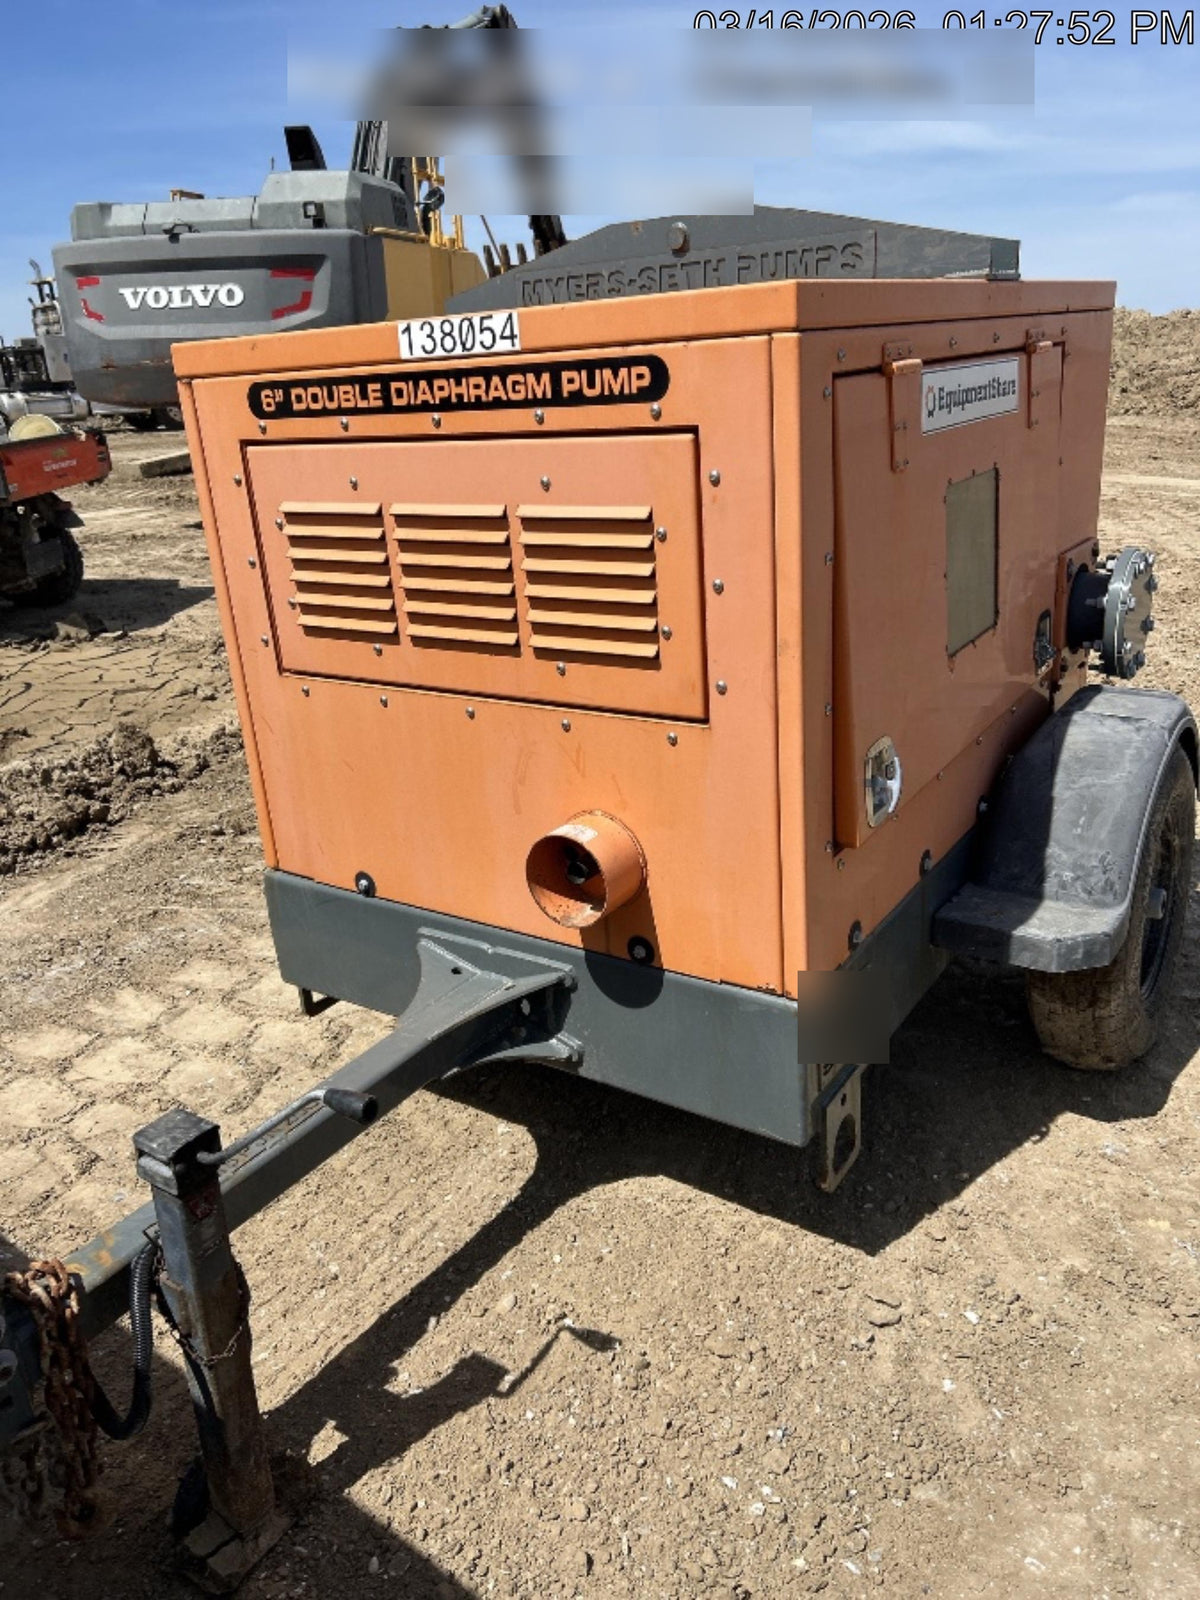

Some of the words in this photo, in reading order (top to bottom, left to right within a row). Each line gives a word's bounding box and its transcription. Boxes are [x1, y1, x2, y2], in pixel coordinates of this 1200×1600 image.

[118, 282, 244, 311] VOLVO
[522, 253, 726, 306] MYERS-SETH
[737, 242, 864, 284] PUMPS
[401, 312, 518, 356] 138054
[259, 387, 284, 412] 6"
[290, 382, 384, 412] DOUBLE
[390, 371, 552, 407] DIAPHRAGM
[561, 365, 652, 398] PUMP
